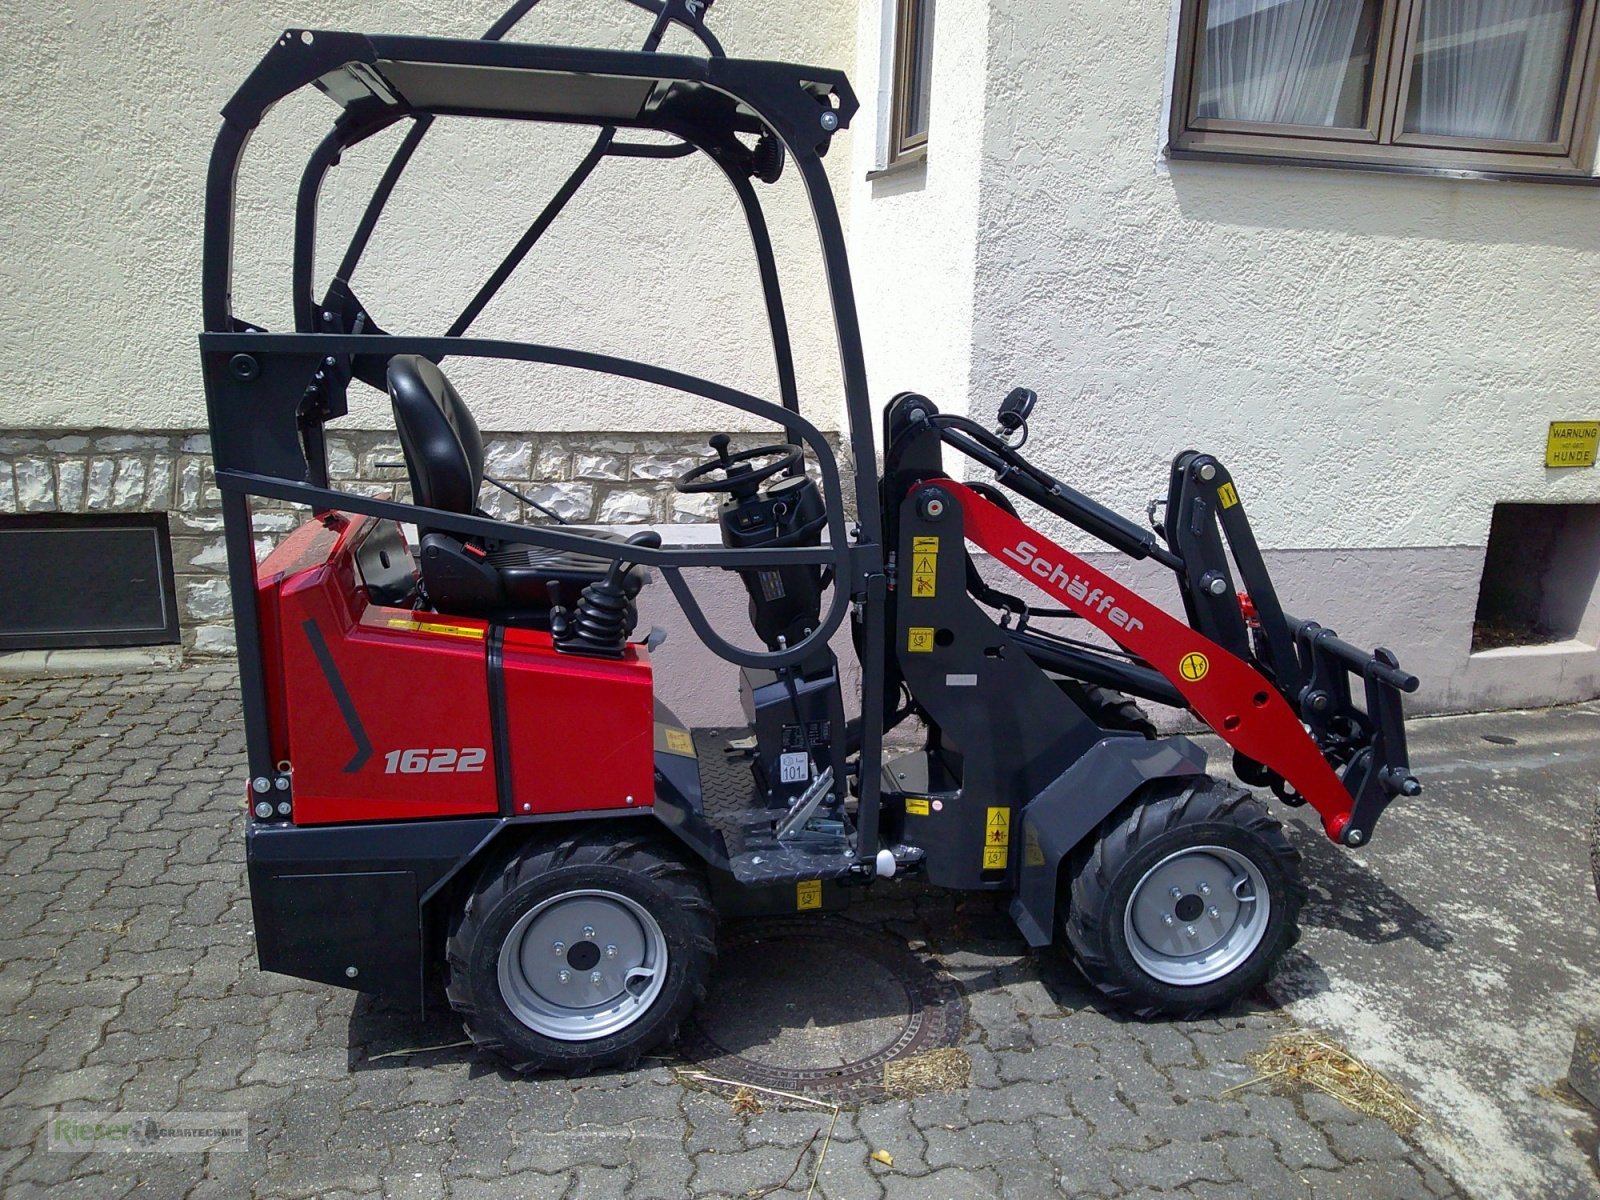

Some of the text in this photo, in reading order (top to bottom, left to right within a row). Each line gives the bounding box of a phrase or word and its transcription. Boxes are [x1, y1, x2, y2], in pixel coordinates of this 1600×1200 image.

[1553, 428, 1597, 438] WARNUNG
[1553, 451, 1590, 461] HUNDE
[1002, 541, 1144, 632] Schäffer
[384, 747, 486, 774] 1622
[783, 766, 801, 780] 101
